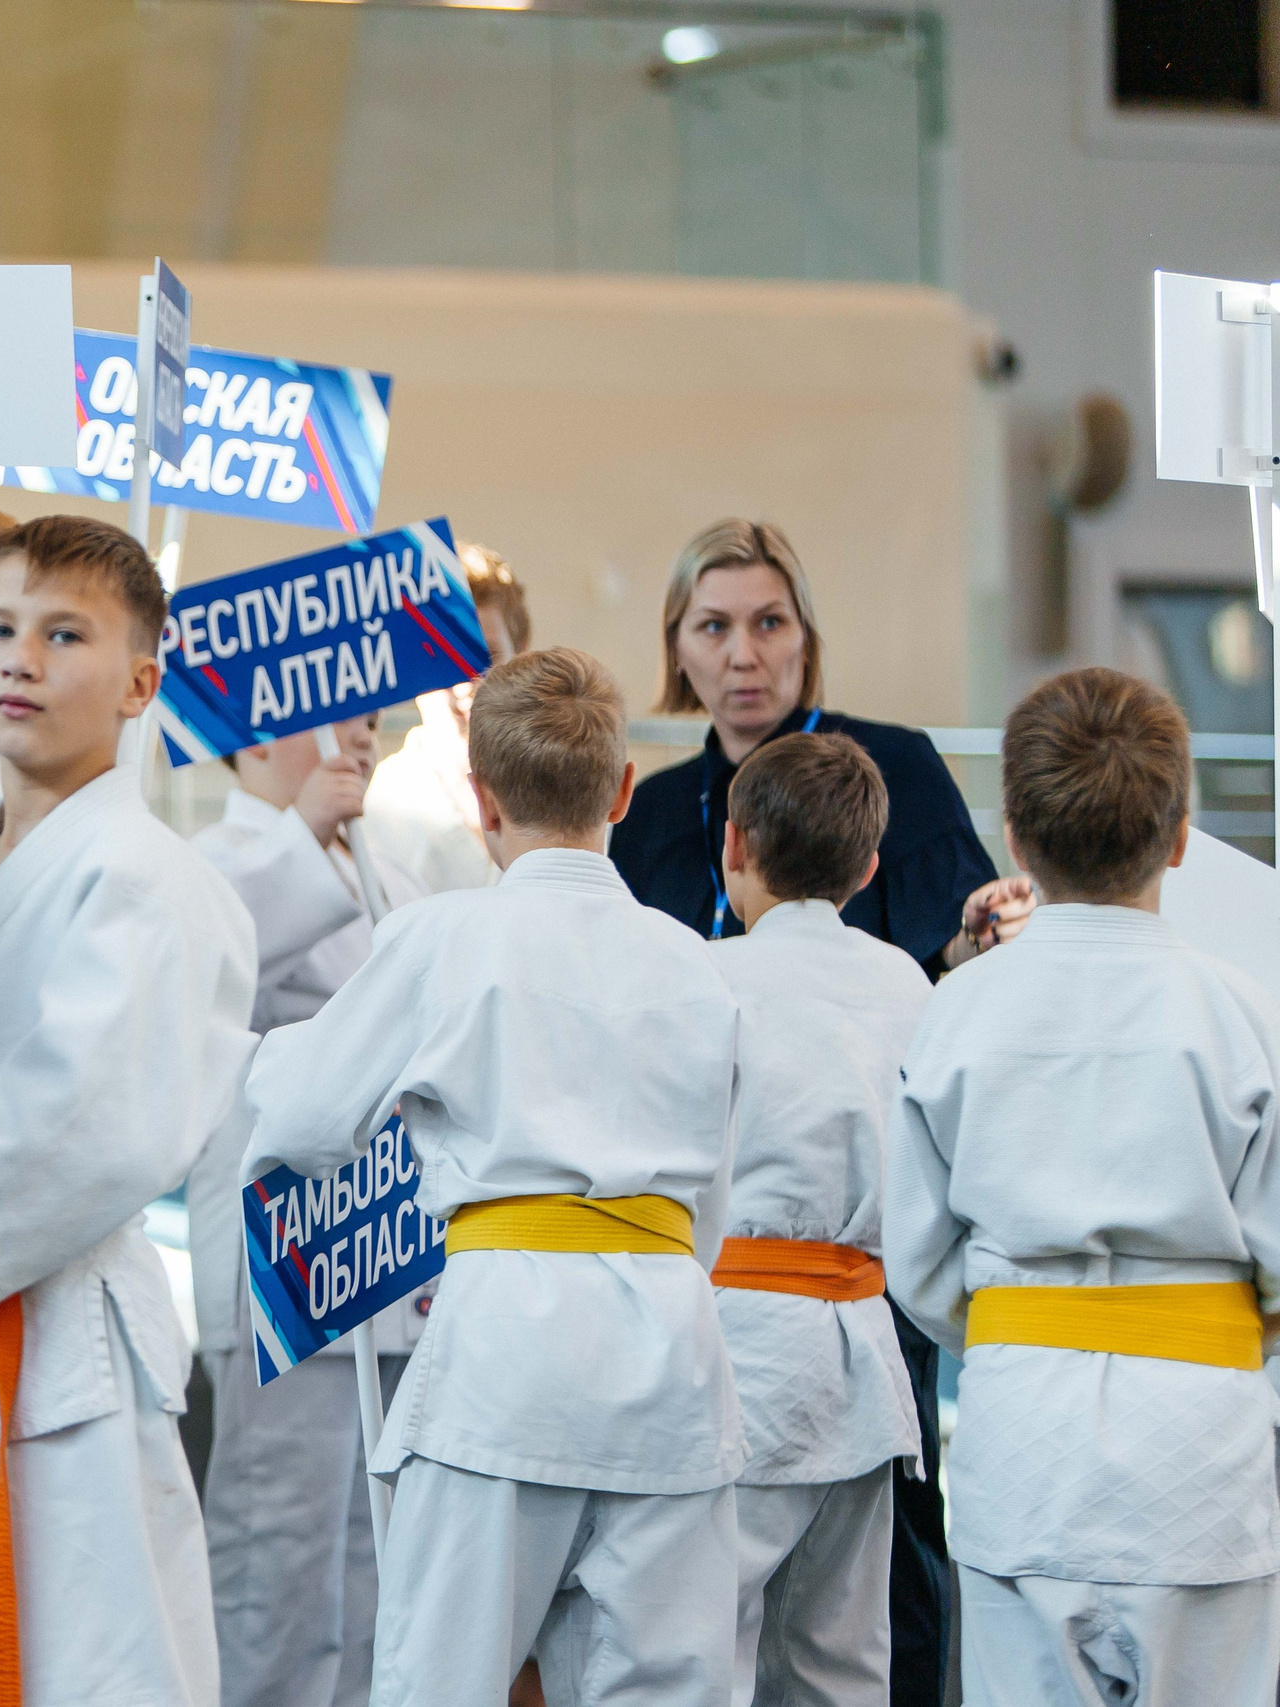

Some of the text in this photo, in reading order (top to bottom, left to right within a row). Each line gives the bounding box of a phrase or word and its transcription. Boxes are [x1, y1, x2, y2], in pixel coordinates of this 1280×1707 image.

[89, 356, 314, 440] ОСКАЯ
[157, 547, 451, 676] РЕСПУБЛИКА
[249, 616, 398, 728] АЛТАЙ
[264, 1120, 419, 1265] ТАМБОВС
[309, 1194, 449, 1320] ОБЛАСТЬ
